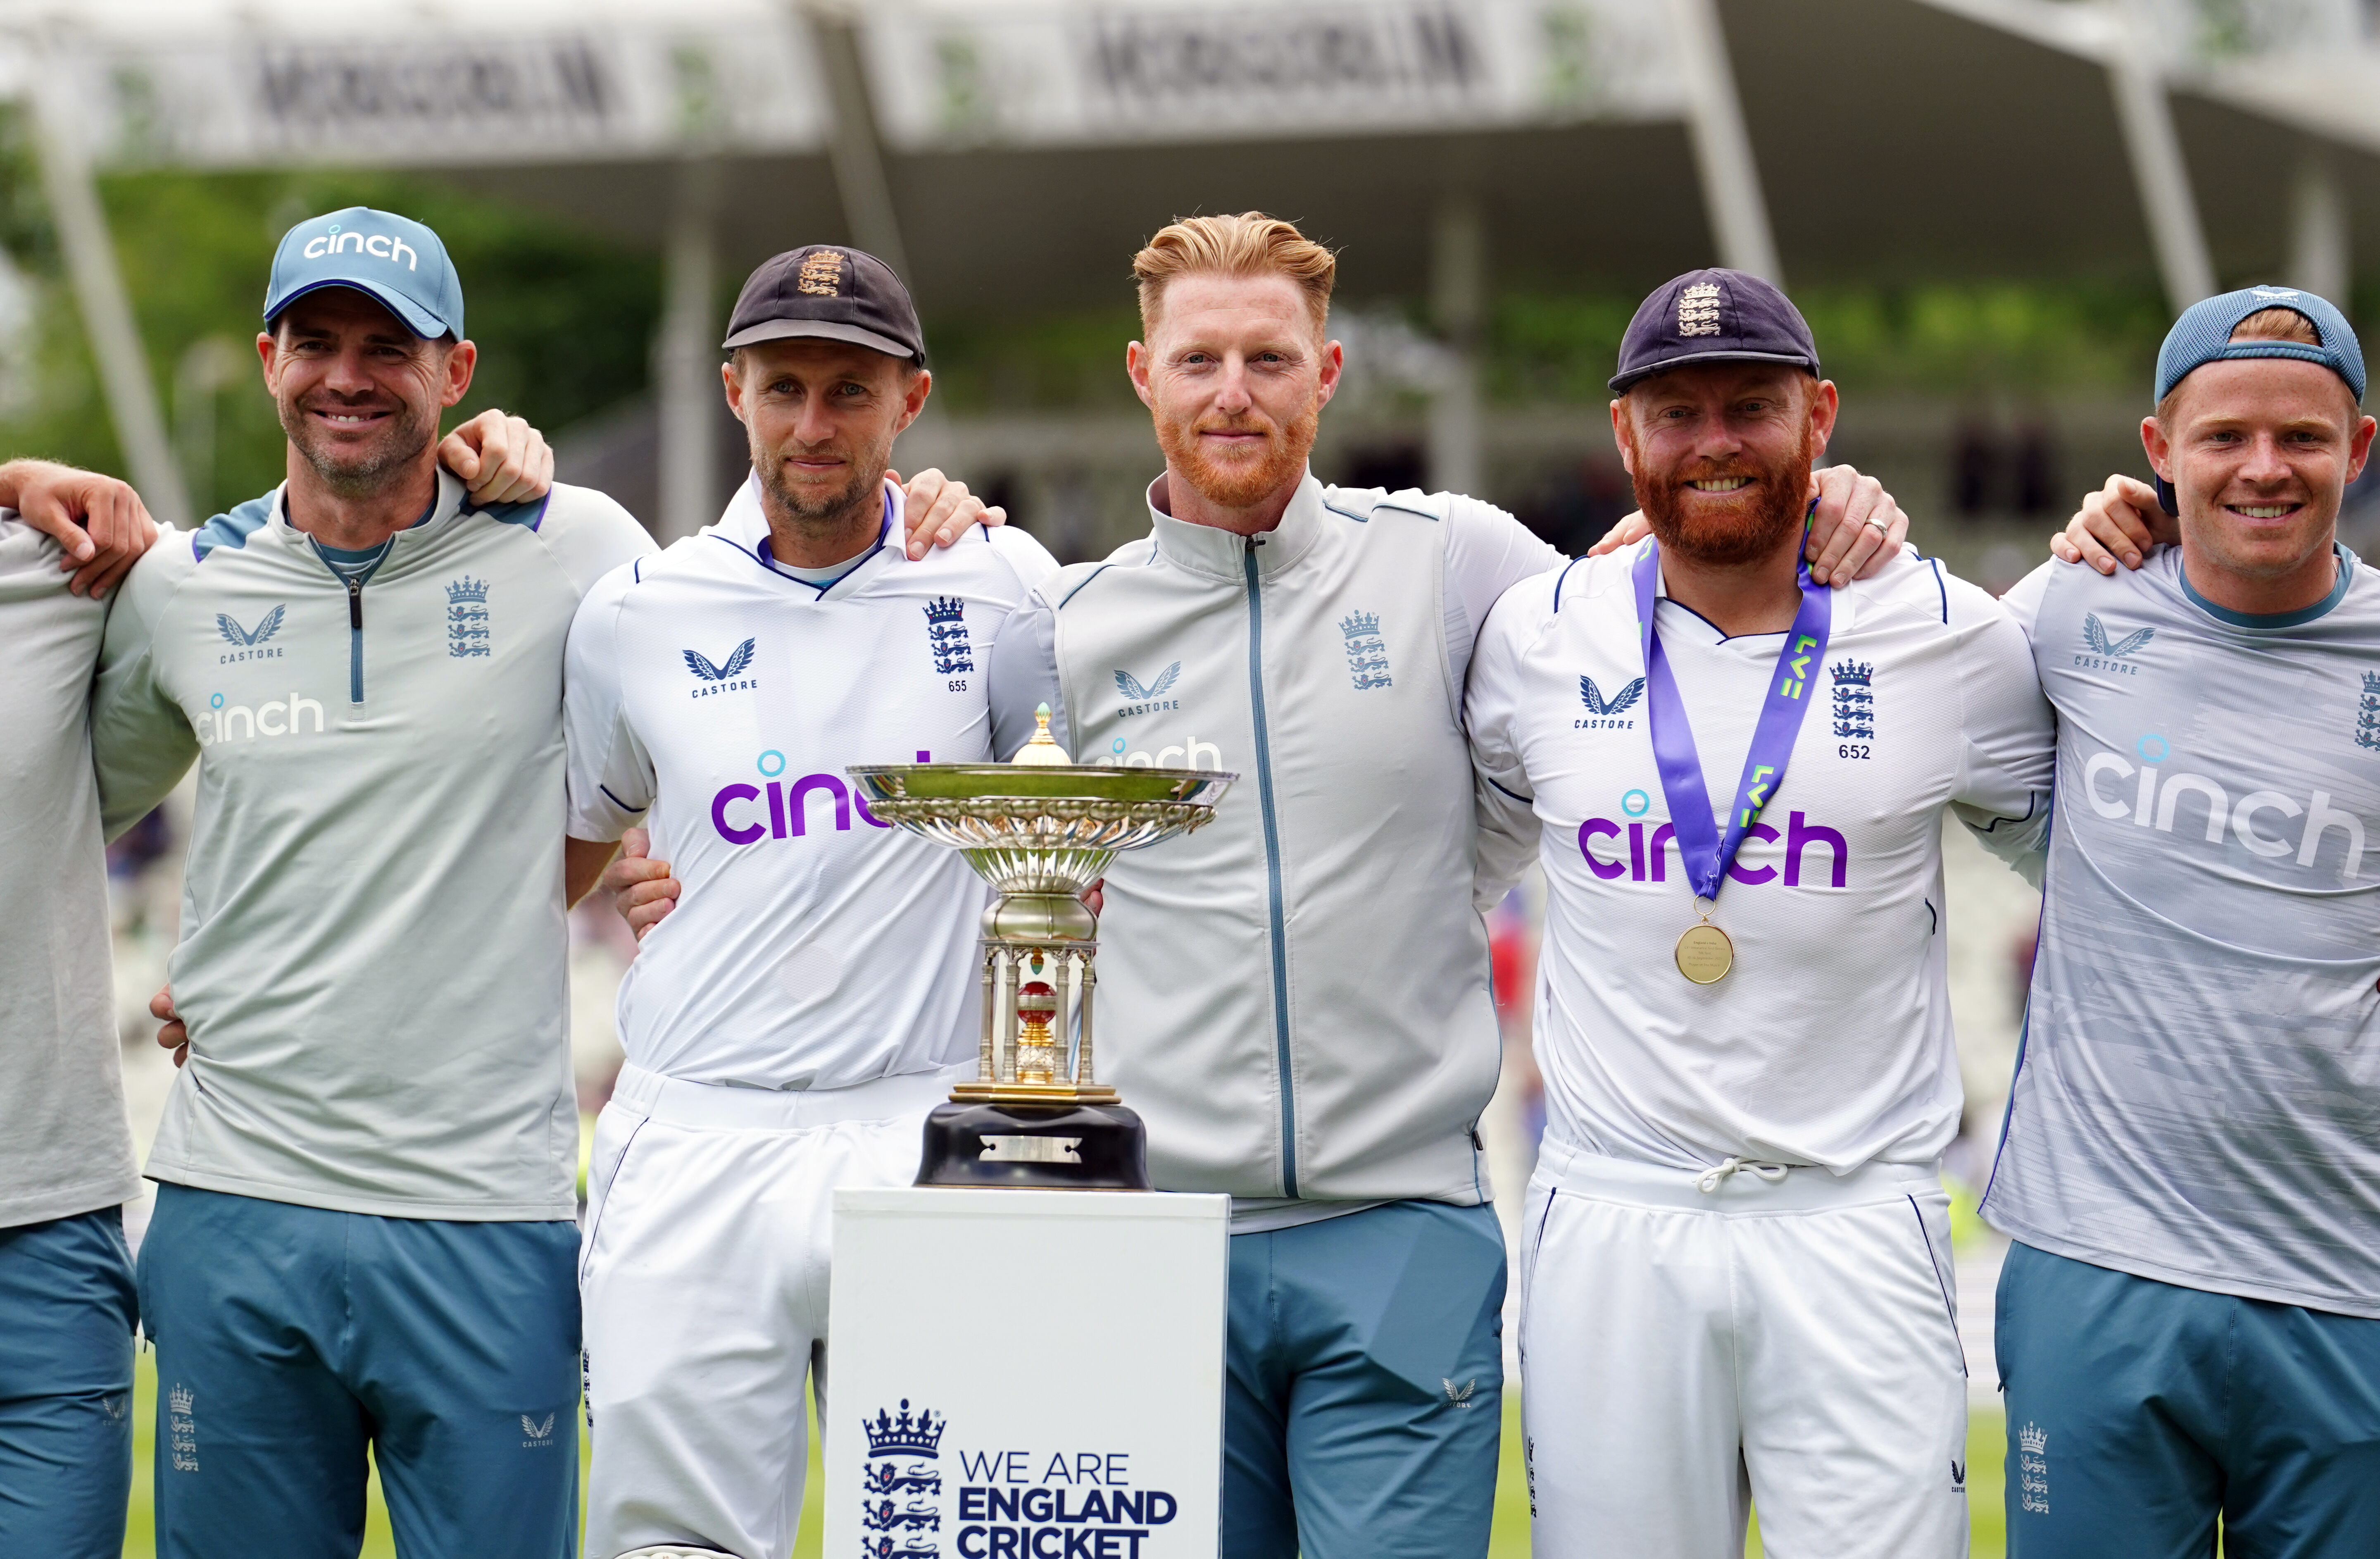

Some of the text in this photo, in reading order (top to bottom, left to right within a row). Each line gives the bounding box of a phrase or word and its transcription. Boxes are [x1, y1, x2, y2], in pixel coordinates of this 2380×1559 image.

[304, 224, 417, 271] cinch
[221, 648, 283, 664] CASTORE
[2075, 656, 2137, 675] CASTORE
[692, 680, 757, 698] CASTORE
[949, 680, 966, 691] 655
[196, 692, 324, 746] cinch
[1118, 700, 1178, 717] CASTORE
[1575, 720, 1633, 729] CASTORE
[1095, 736, 1222, 772] inch
[1839, 744, 1870, 759] 652
[712, 750, 930, 845] cin
[2085, 734, 2365, 879] cinch
[960, 1450, 1129, 1485] WE ARE
[959, 1487, 1177, 1524] ENGLAND
[957, 1525, 1149, 1559] CRICKET
